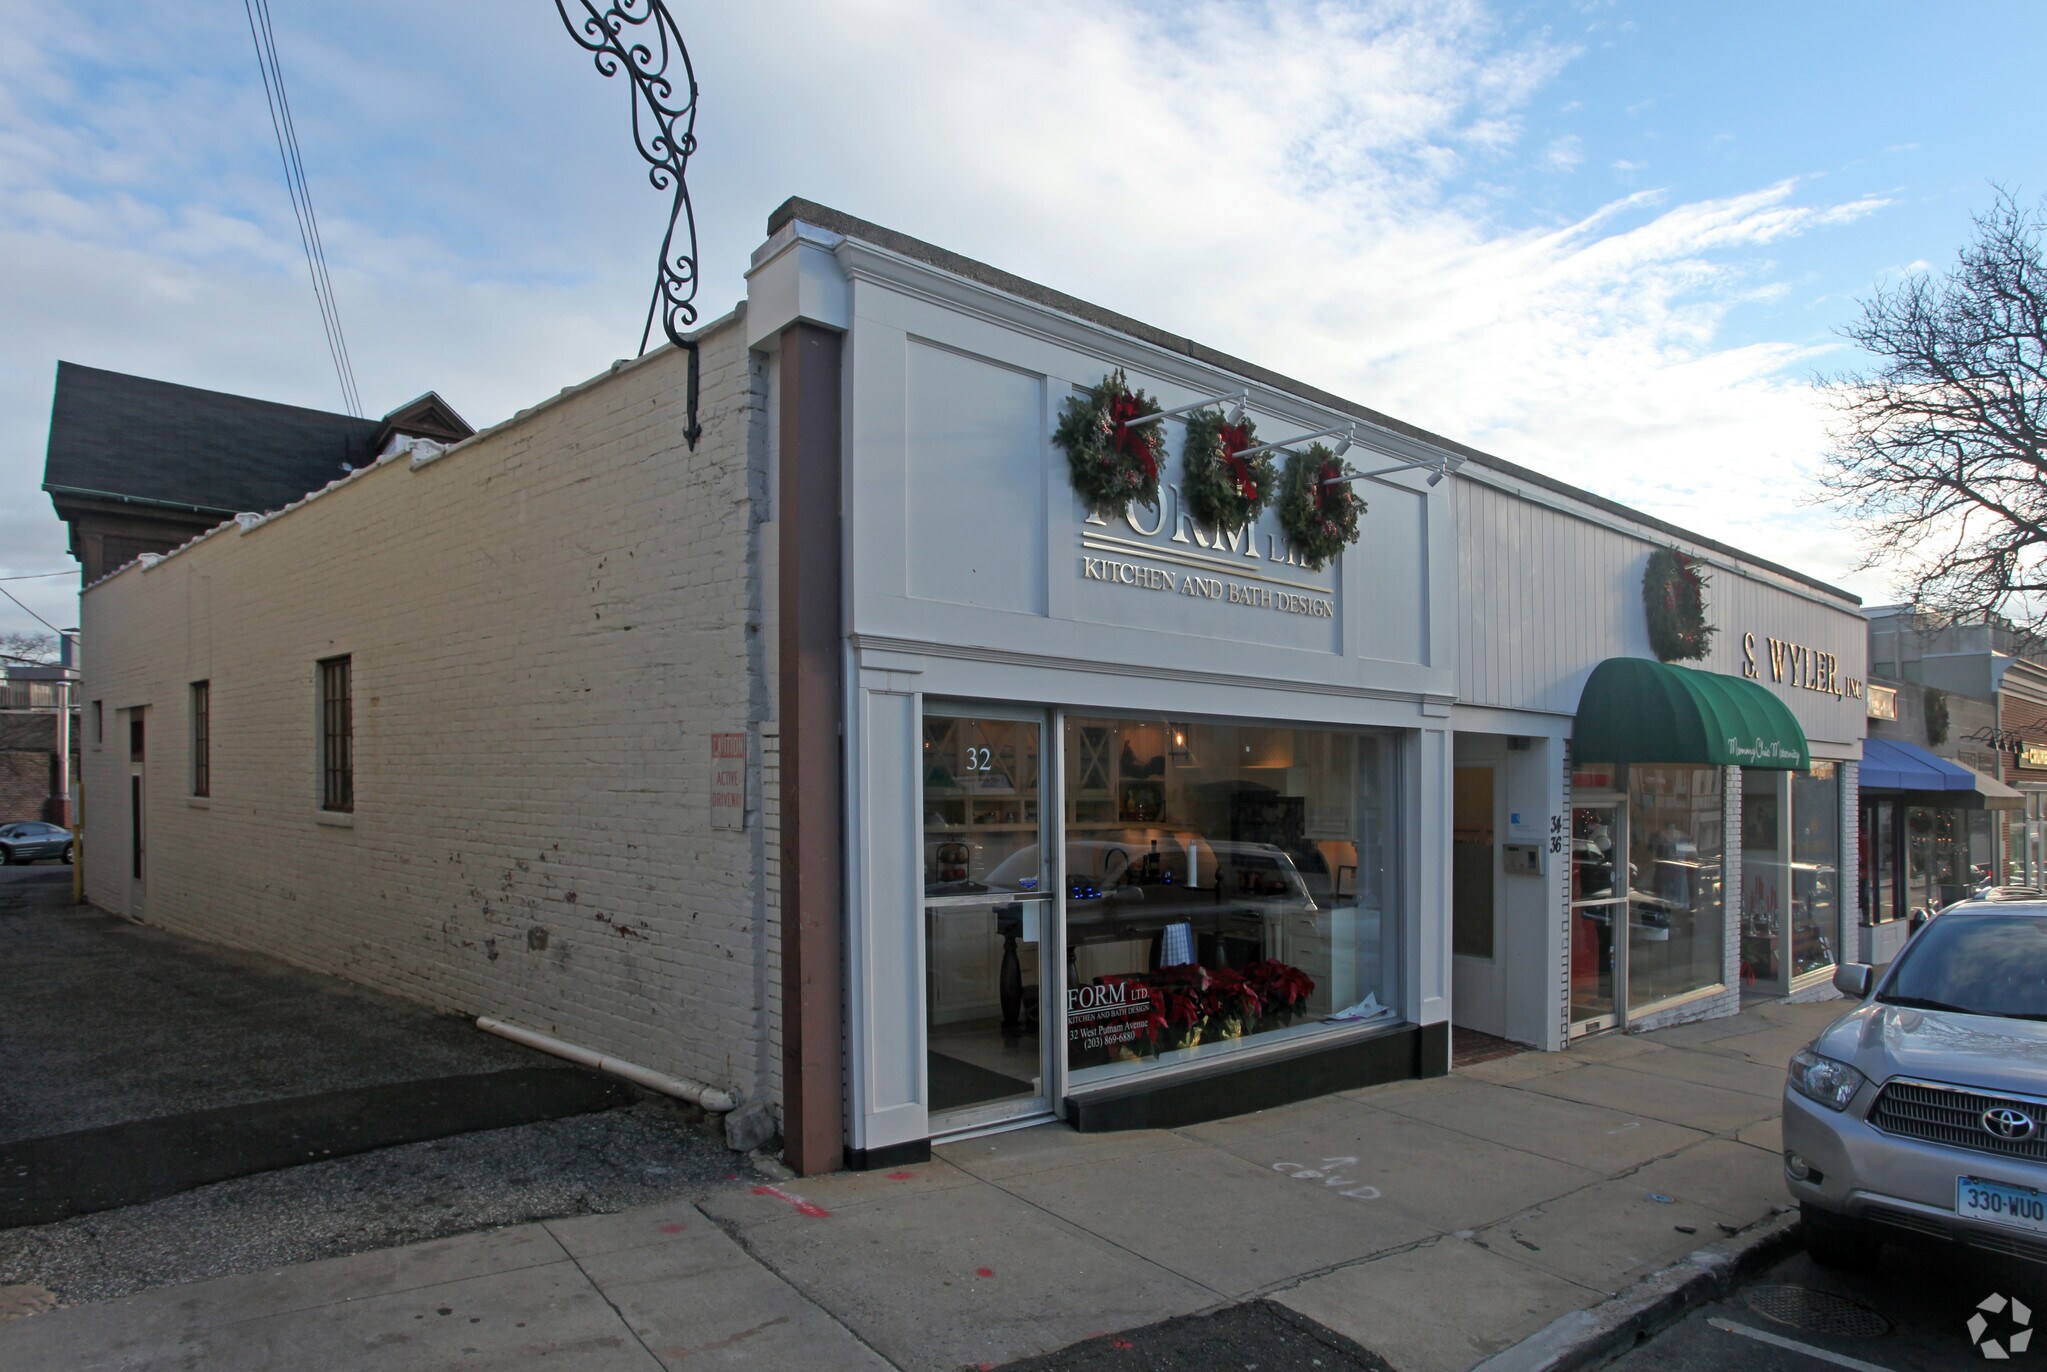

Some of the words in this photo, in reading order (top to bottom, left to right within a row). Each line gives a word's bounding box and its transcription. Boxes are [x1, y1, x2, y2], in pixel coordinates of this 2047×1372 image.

[1083, 556, 1176, 592] KITCHEN
[1181, 575, 1223, 600] AND
[1228, 582, 1272, 608] BATH
[1277, 591, 1334, 618] DESIGN
[1743, 632, 1760, 679] S.
[1767, 637, 1843, 702] WYLER,
[1845, 676, 1862, 699] INC
[966, 747, 992, 771] 32
[1728, 737, 1756, 763] Mommy
[717, 771, 739, 786] ACTIVE
[1550, 815, 1562, 833] 34
[1550, 836, 1562, 853] 36
[1067, 982, 1126, 1010] FORM
[1131, 988, 1150, 1001] LTD.
[1068, 1013, 1095, 1025] KITCHEN
[1096, 1010, 1110, 1020] AND
[1111, 1008, 1127, 1017] BATH
[1128, 1004, 1150, 1014] DESIGN
[1069, 1029, 1079, 1041] 32
[1080, 1027, 1097, 1038] West
[1098, 1024, 1123, 1036] Putnam
[1125, 1020, 1149, 1031] Avenue
[1084, 1036, 1103, 1051] (203)
